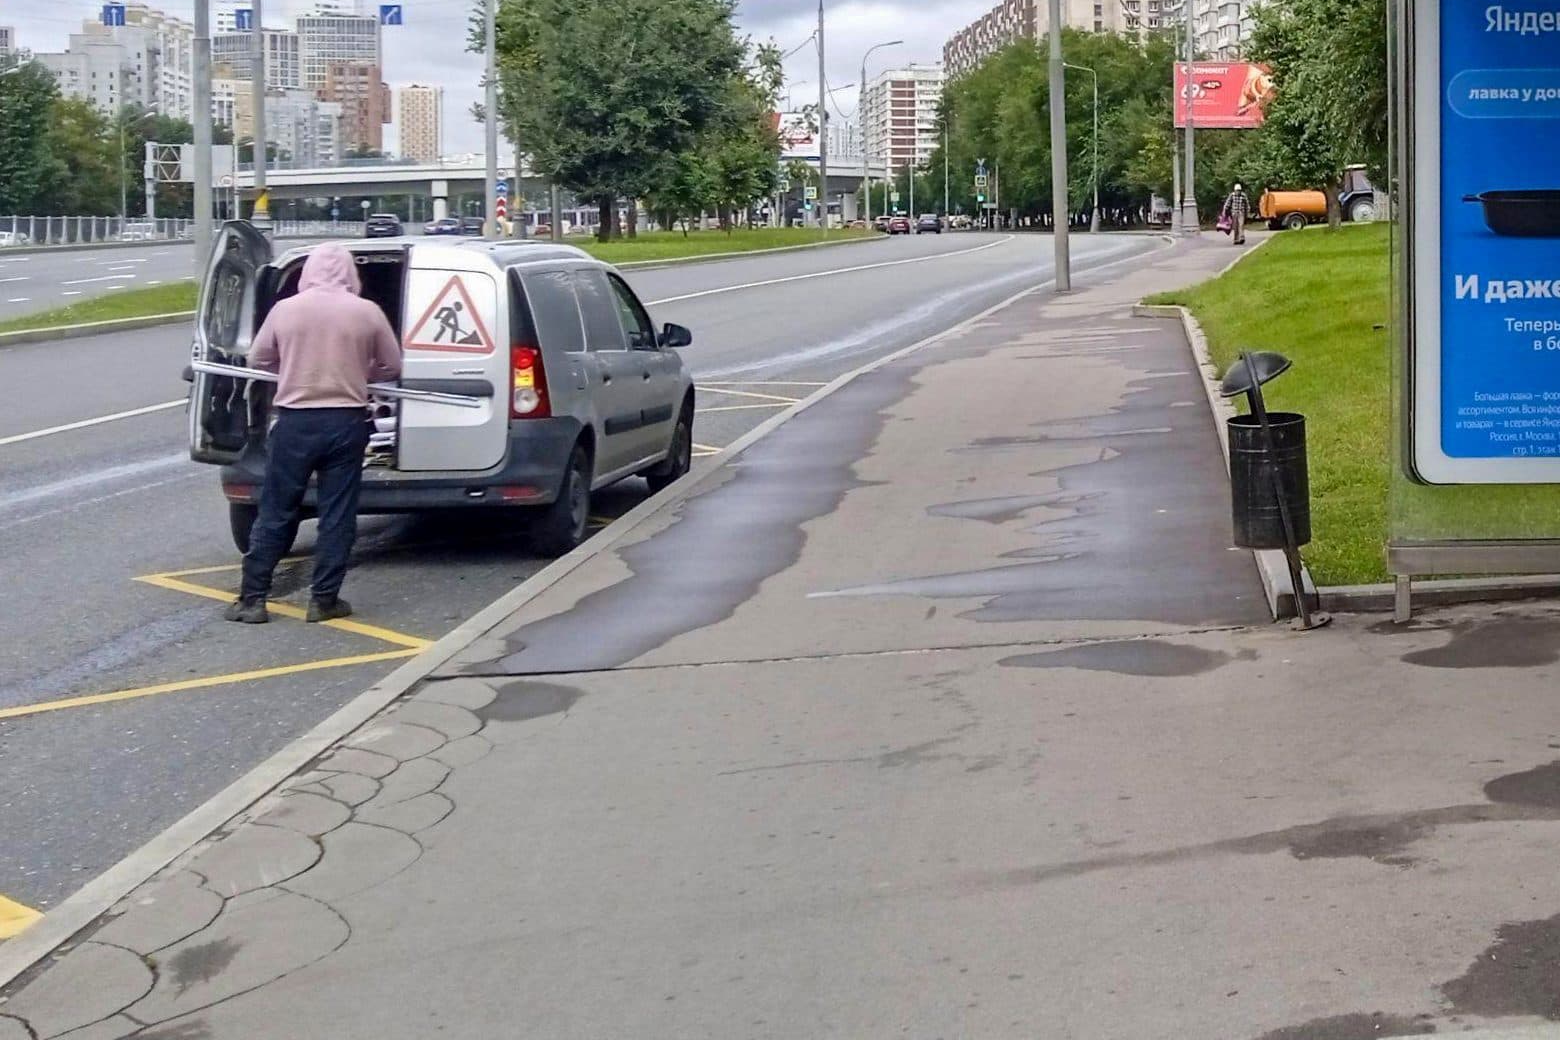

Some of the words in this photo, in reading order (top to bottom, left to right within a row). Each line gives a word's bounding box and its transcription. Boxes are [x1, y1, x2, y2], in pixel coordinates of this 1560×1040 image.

[1468, 86, 1519, 101] лавка
[1521, 87, 1532, 103] у
[1455, 275, 1479, 300] И
[1533, 340, 1542, 351] в
